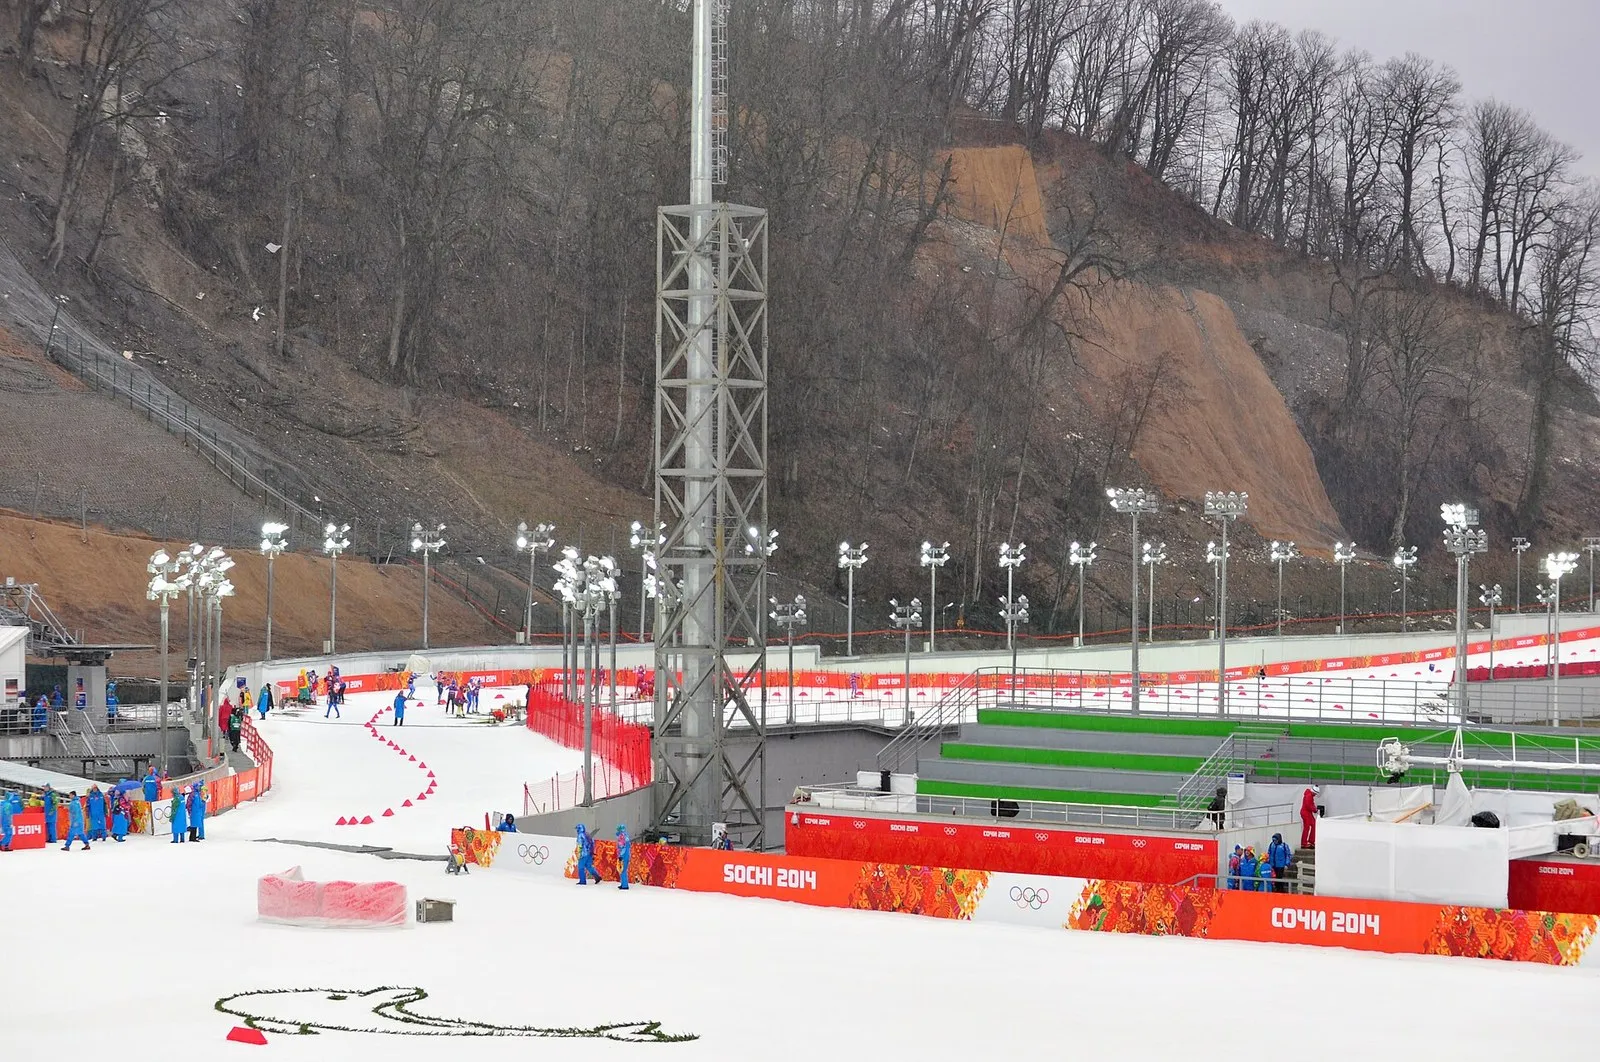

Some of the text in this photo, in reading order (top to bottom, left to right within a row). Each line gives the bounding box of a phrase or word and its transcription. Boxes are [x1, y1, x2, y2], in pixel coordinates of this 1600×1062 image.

[18, 824, 41, 835] 2014
[723, 863, 817, 890] SOCHI 2014
[1538, 866, 1574, 876] SOCHI 2014
[1271, 907, 1380, 935] СОЧИ 2014
